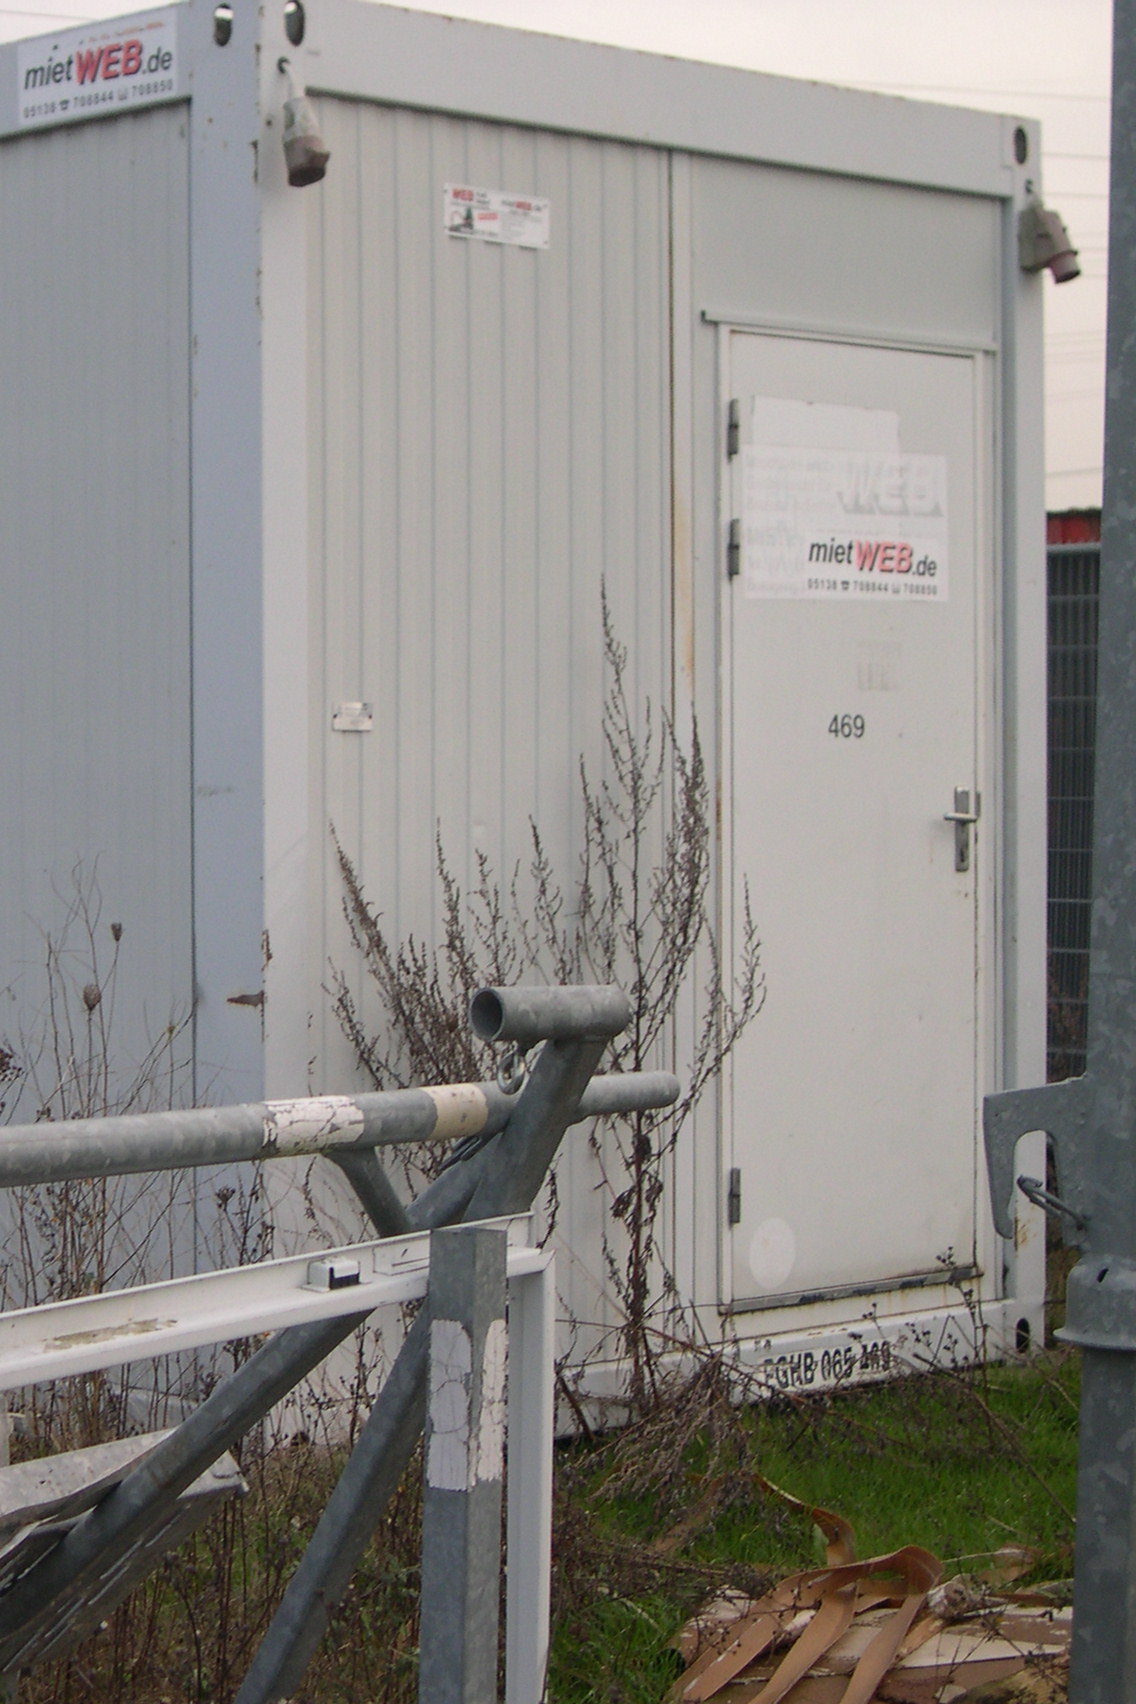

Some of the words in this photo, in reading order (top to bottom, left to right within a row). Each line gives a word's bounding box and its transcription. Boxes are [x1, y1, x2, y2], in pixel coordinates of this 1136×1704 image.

[24, 39, 173, 90] mietWEB.de
[808, 537, 938, 577] mietWEB.de
[828, 714, 865, 738] 469
